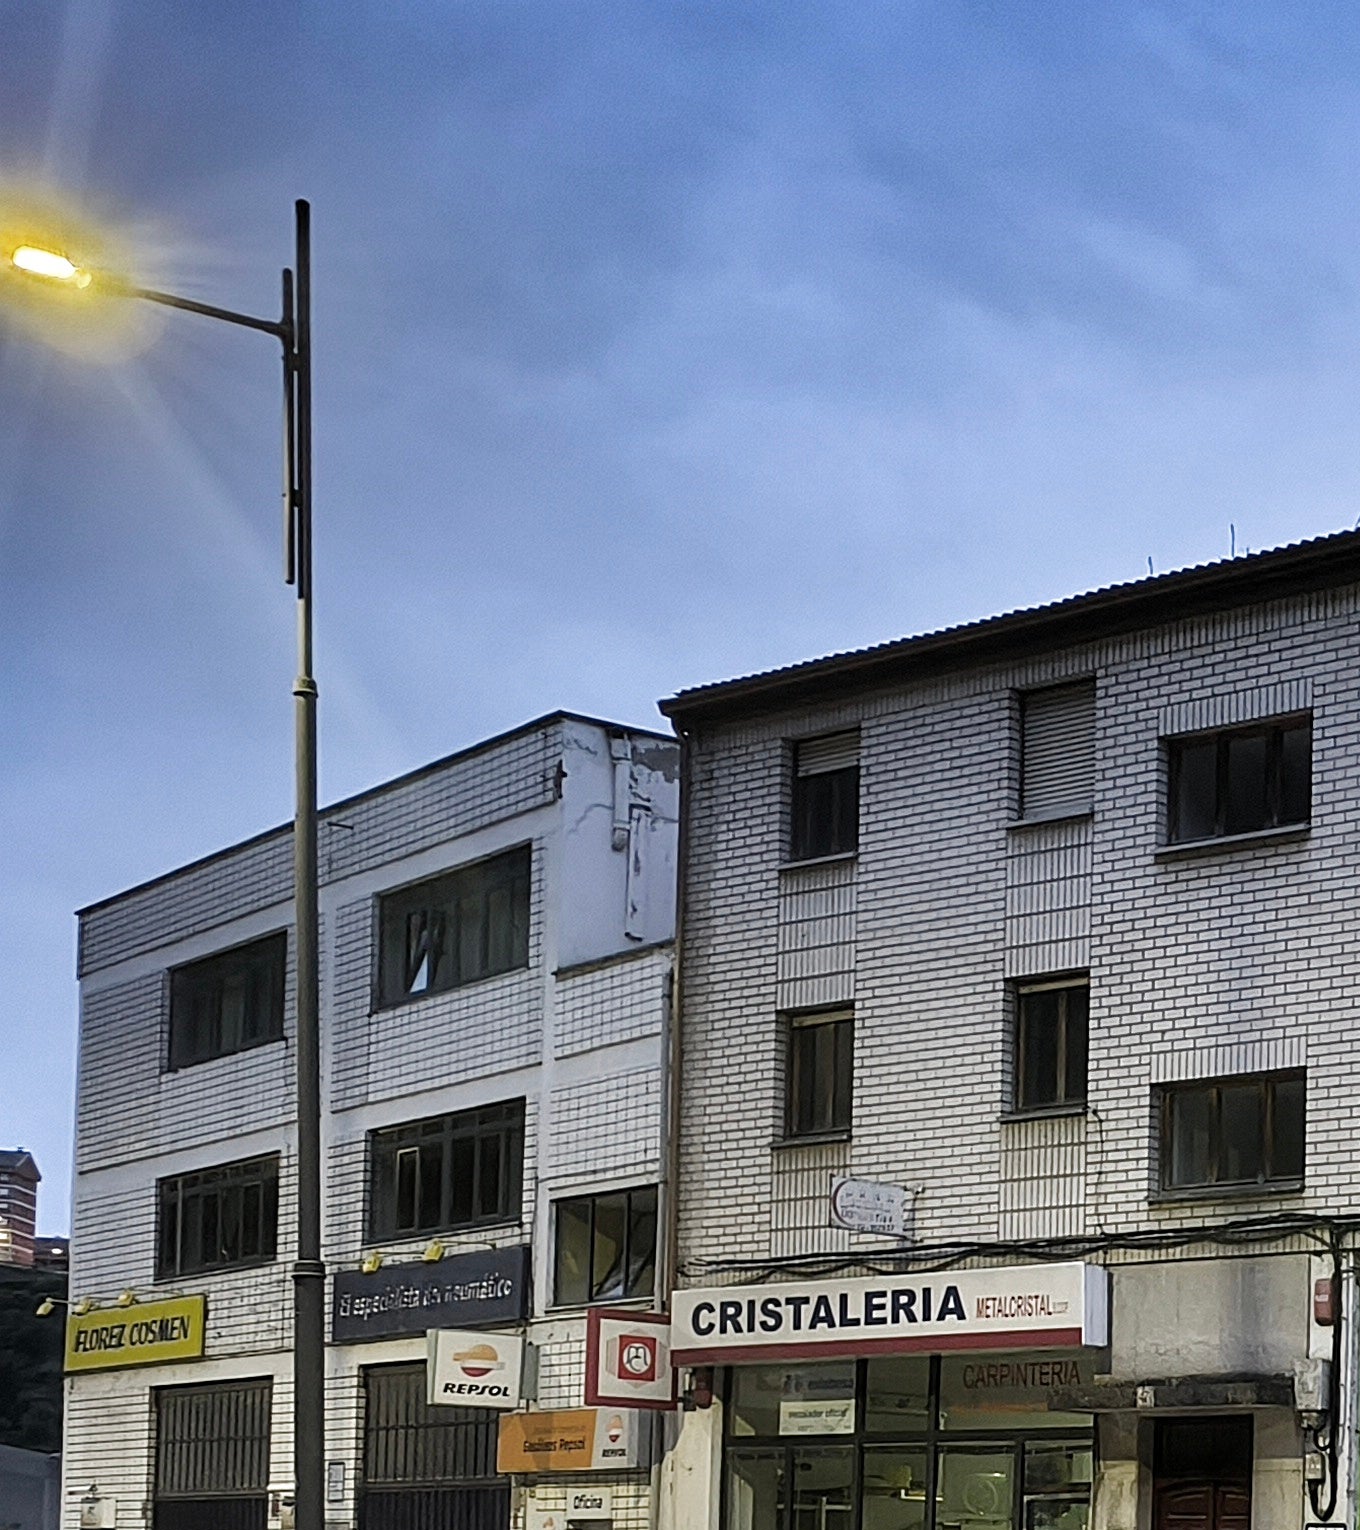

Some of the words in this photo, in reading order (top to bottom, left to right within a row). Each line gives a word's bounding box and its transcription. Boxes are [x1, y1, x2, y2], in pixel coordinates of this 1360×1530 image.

[691, 1284, 967, 1337] CRISTALERIA
[74, 1323, 127, 1353] FLOREZ
[129, 1315, 191, 1346] COSMEN
[443, 1382, 511, 1398] REPSOL
[962, 1360, 1081, 1390] CARPINTERIA
